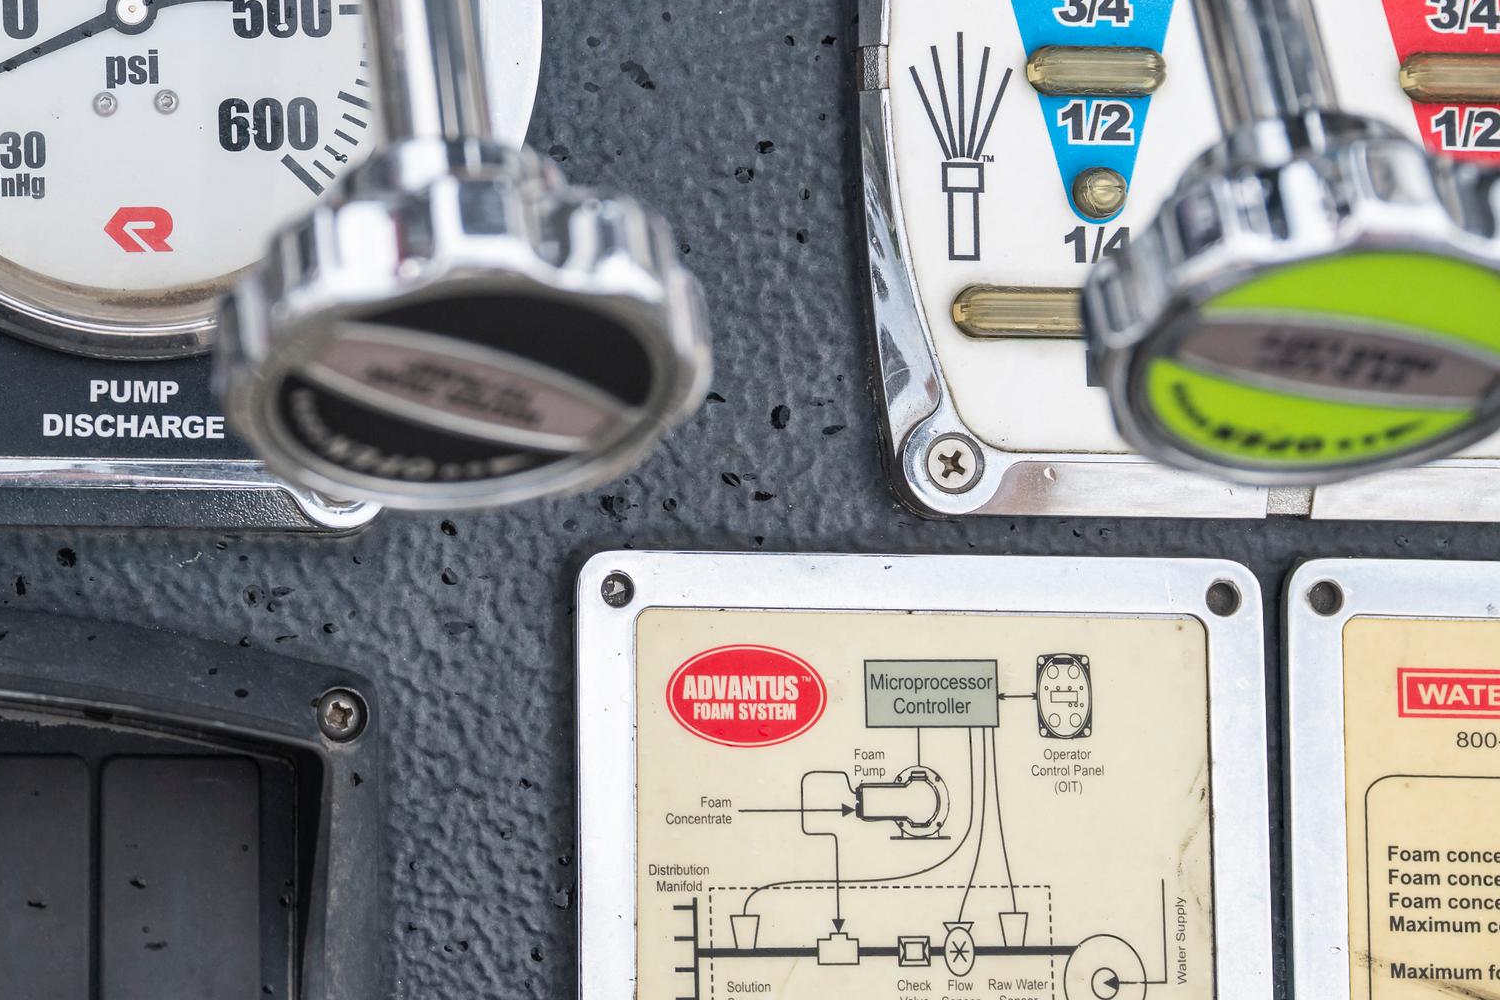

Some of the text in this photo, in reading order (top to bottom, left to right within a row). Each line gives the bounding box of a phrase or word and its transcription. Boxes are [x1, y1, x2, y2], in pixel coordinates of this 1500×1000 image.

[106, 49, 159, 89] psi
[218, 97, 318, 152] 600
[1058, 100, 1134, 146] 1/2
[1431, 107, 1500, 151] 1/2
[90, 380, 179, 403] PUMP
[43, 414, 224, 438] DISCHARGE
[683, 675, 798, 700] ADVANTUS
[871, 674, 992, 694] Microprocessor
[694, 703, 796, 720] FOAM SYSTEM
[894, 698, 971, 714] Controller
[1456, 731, 1500, 749] 800
[855, 749, 884, 760] Foam
[1044, 749, 1091, 762] Operator
[855, 765, 885, 779] Pump
[1031, 765, 1104, 776] Control Panel
[1055, 781, 1082, 794] (OIT)
[701, 796, 731, 808] Foam
[666, 813, 732, 824] Concentrate
[1388, 846, 1439, 862] Foam
[649, 864, 709, 875] Distribution
[1389, 869, 1440, 885] Foam
[657, 880, 702, 892] Manifold
[1389, 892, 1441, 909] Foam
[1390, 916, 1480, 933] Maximum
[1175, 897, 1187, 984] Water Supply
[1391, 963, 1482, 980] Maximum
[727, 981, 771, 993] Solution
[897, 980, 931, 991] Check
[948, 980, 973, 991] Flow
[989, 979, 1048, 990] Raw Water
